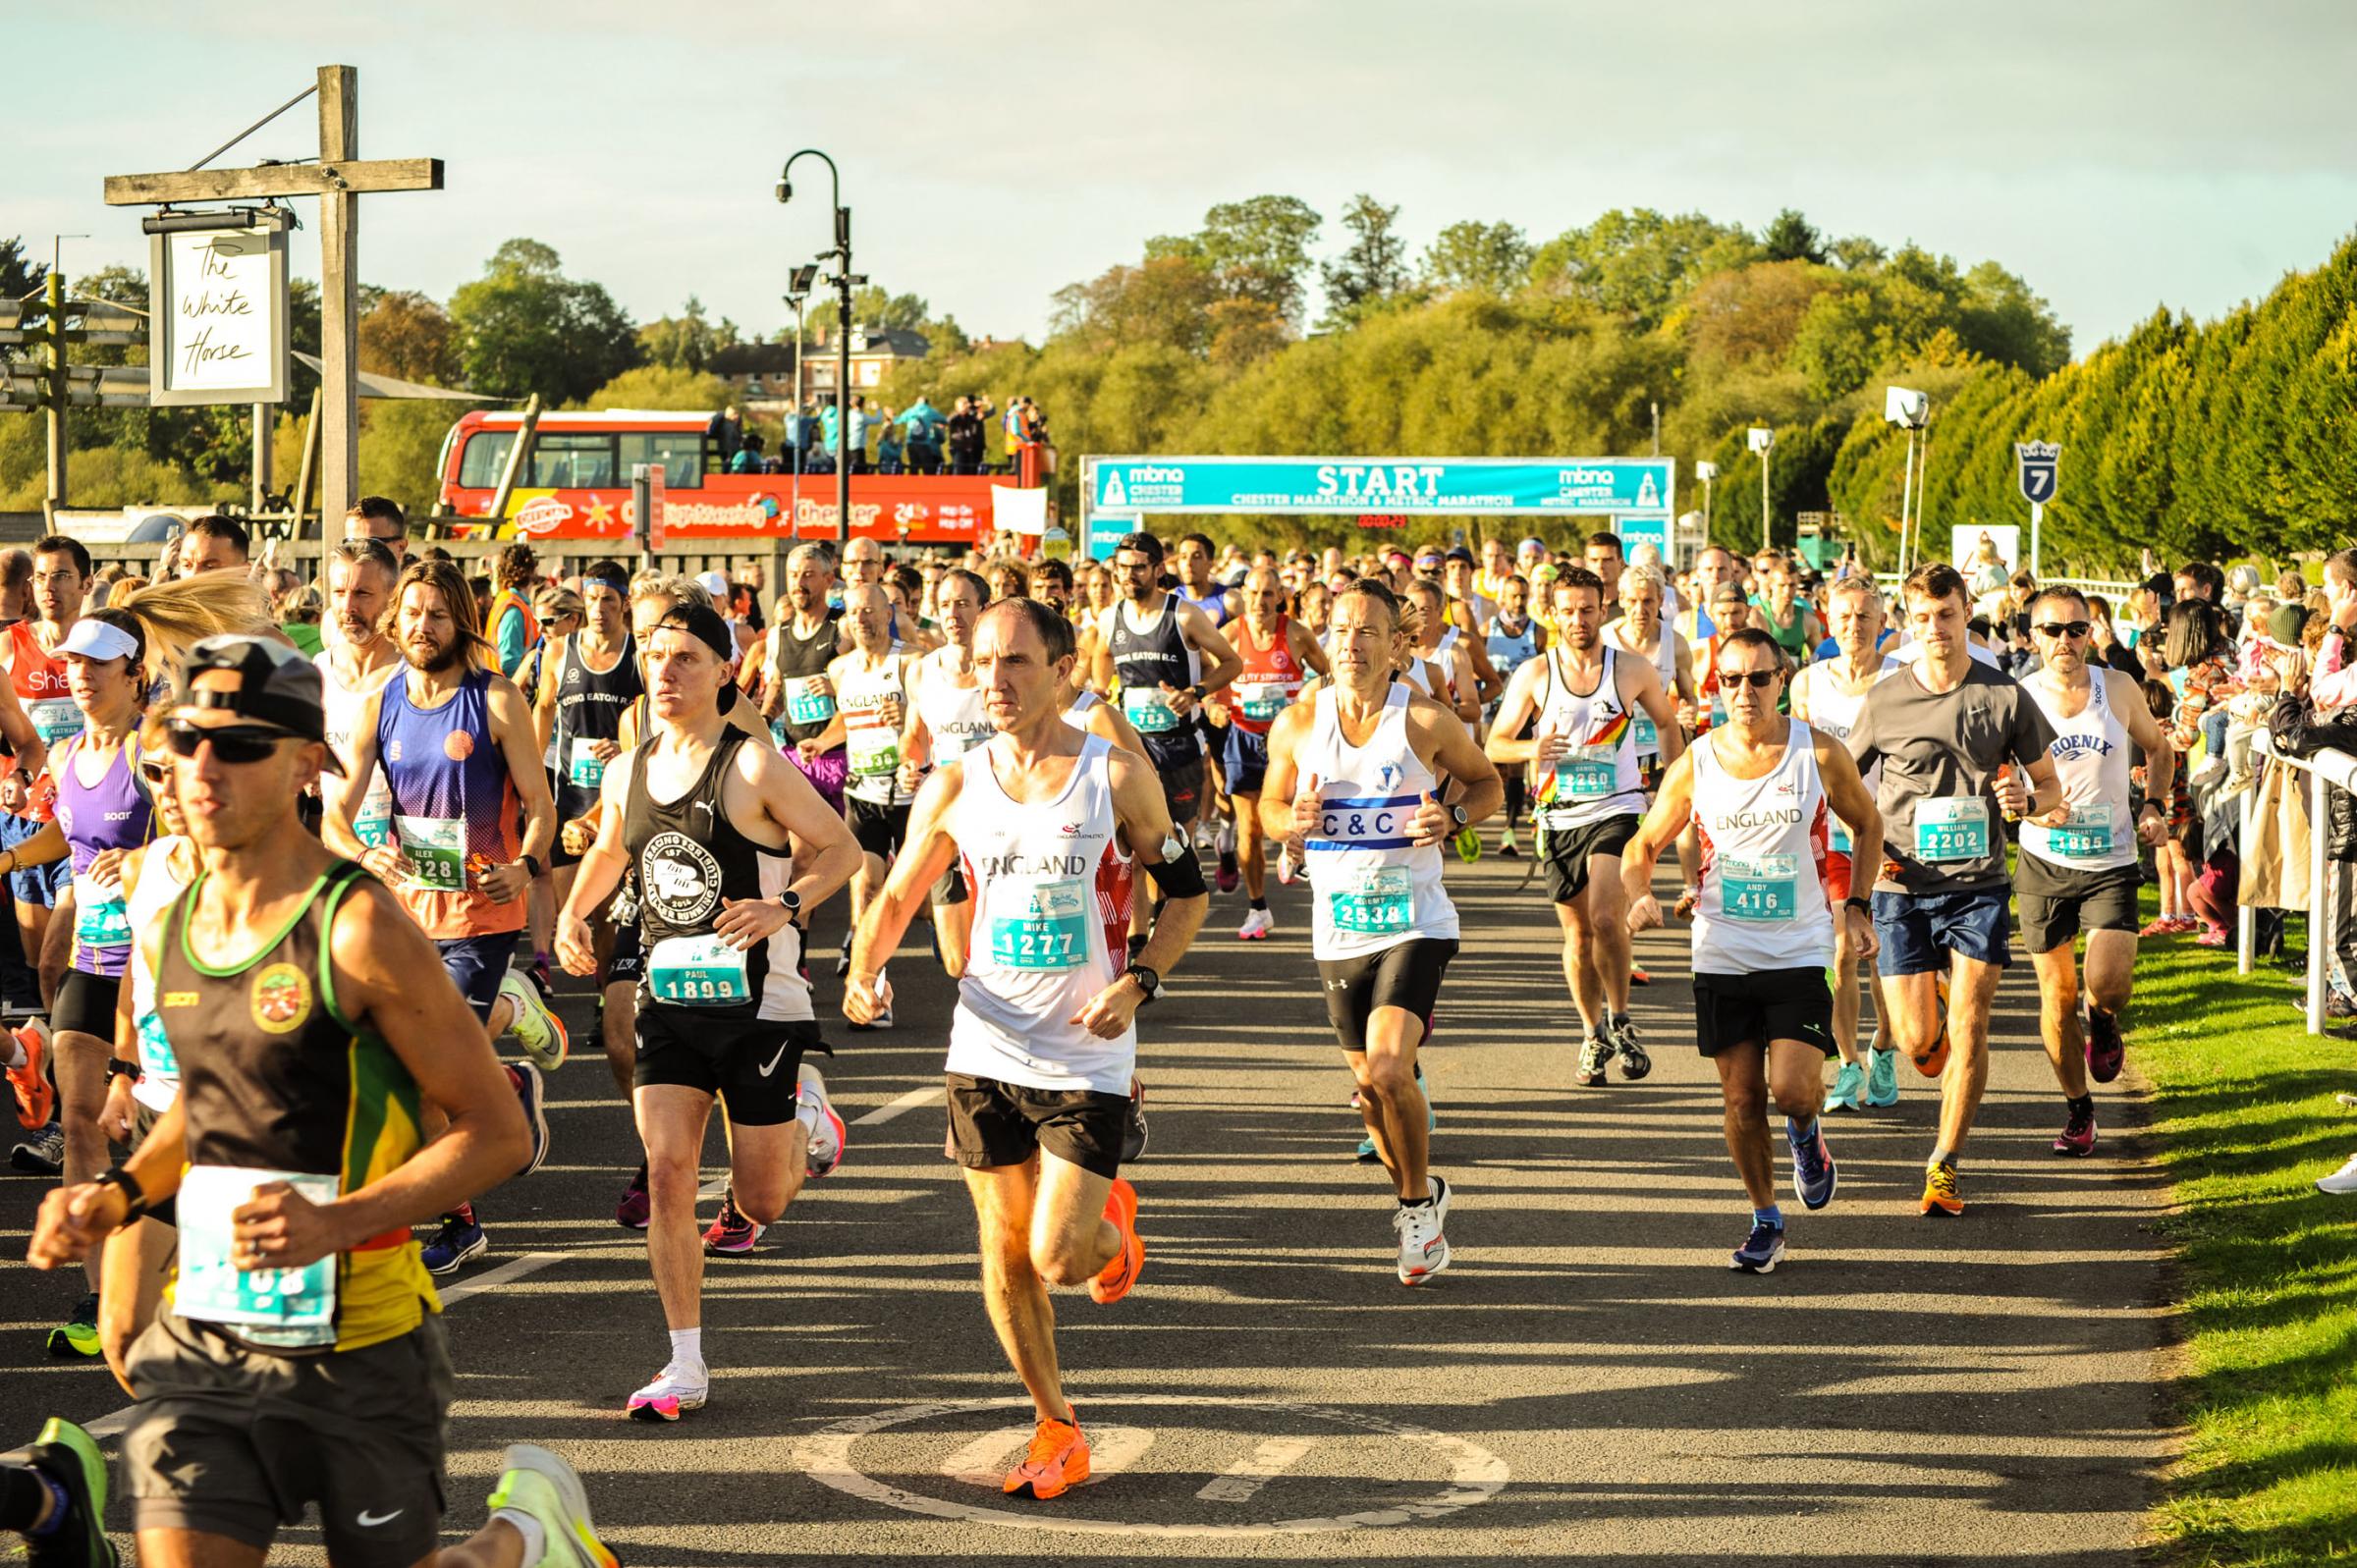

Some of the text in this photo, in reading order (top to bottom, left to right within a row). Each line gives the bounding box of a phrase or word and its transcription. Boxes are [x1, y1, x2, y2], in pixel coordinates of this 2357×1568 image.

[192, 243, 244, 280] The
[183, 290, 253, 318] White
[184, 326, 253, 375] Horse
[1129, 465, 1184, 483] mbna
[1317, 466, 1444, 497] START
[1559, 466, 1615, 484] mbna
[2030, 469, 2050, 495] 7
[1129, 484, 1182, 496] CHESTER
[1560, 487, 1613, 498] CHESTER
[1232, 494, 1290, 506] CHESTER
[1293, 494, 1369, 506] MARATHON
[1385, 496, 1434, 507] METRIC
[1438, 495, 1513, 507] MARATHON
[796, 499, 881, 527] Cheser
[1622, 531, 1663, 543] mbna
[1131, 652, 1161, 662] EATON
[563, 693, 585, 708] LONG
[586, 692, 619, 704] EATON
[841, 691, 902, 708] NGLAND
[934, 722, 993, 734] NGLAN
[2051, 734, 2113, 758] HOENIX
[103, 810, 134, 822] soar
[1322, 812, 1394, 837] C & C
[1716, 808, 1803, 831] ENGLAND
[1937, 824, 1968, 833] WILLIAM
[645, 836, 681, 862] RACING
[1928, 832, 1978, 849] 2202
[414, 849, 433, 859] ALEX
[703, 857, 719, 888] CLUB
[981, 855, 1086, 876] ENGAND
[1746, 883, 1768, 892] ANDY
[1736, 892, 1778, 909] 416
[1341, 904, 1399, 924] 2538
[1022, 922, 1050, 932] MIKE
[1002, 933, 1073, 956] 1277
[685, 970, 708, 979] PAUL
[665, 981, 734, 1000] 1899
